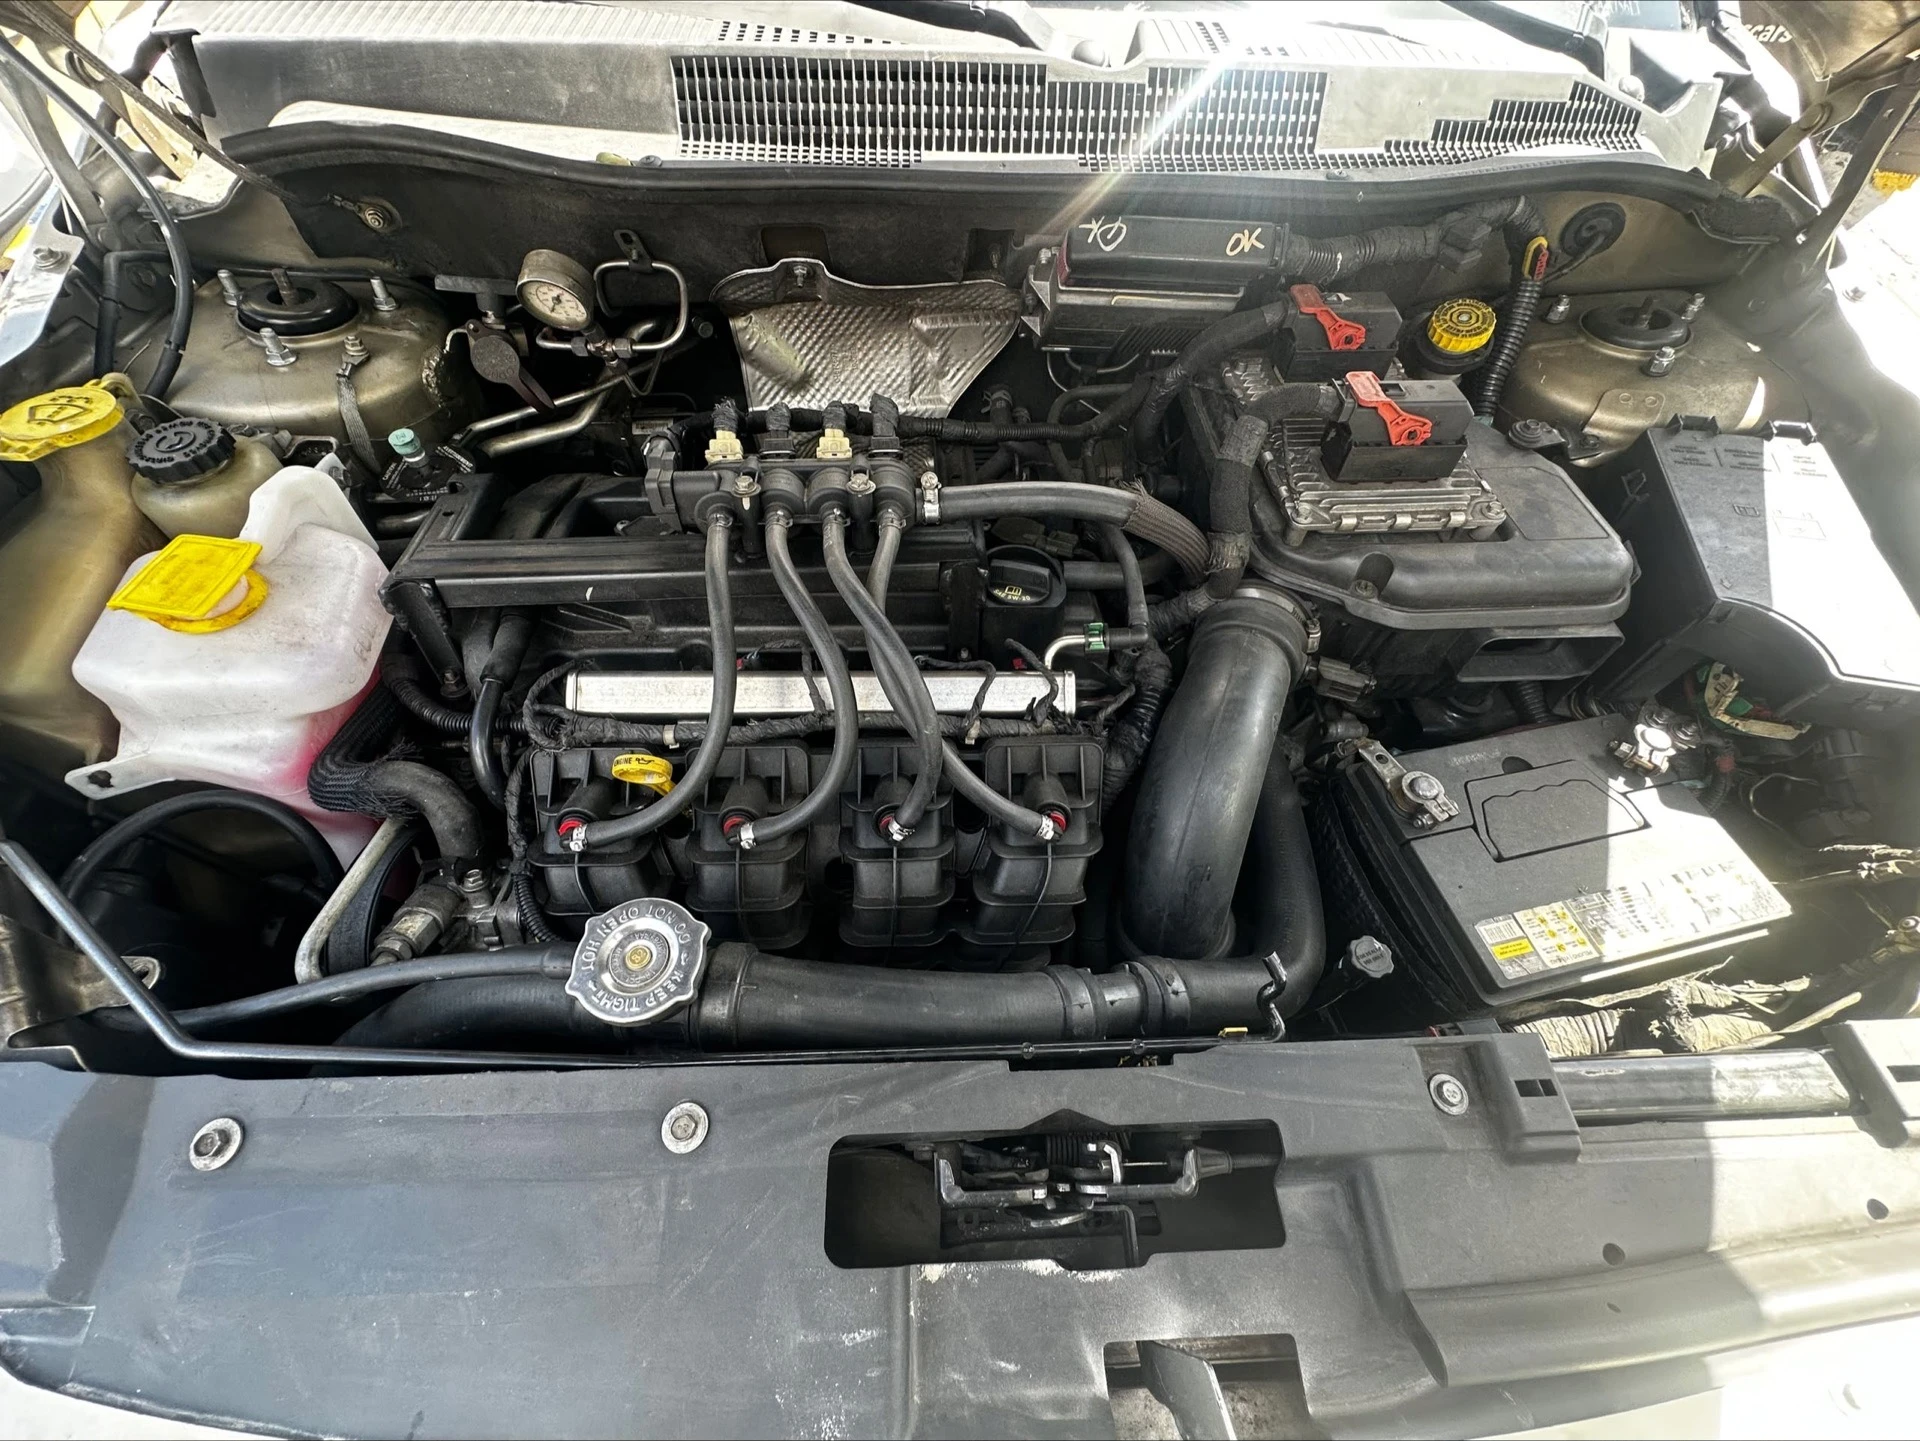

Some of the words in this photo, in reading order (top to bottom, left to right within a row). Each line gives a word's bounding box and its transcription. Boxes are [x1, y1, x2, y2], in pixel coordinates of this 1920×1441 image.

[1225, 227, 1265, 256] OK
[993, 589, 1006, 598] SAE
[597, 907, 639, 937] OPEN
[645, 904, 677, 924] NOT
[674, 922, 692, 944] DO
[581, 939, 600, 971] HOT
[591, 989, 641, 1013] TIGHT
[645, 970, 684, 1007] KEEP
